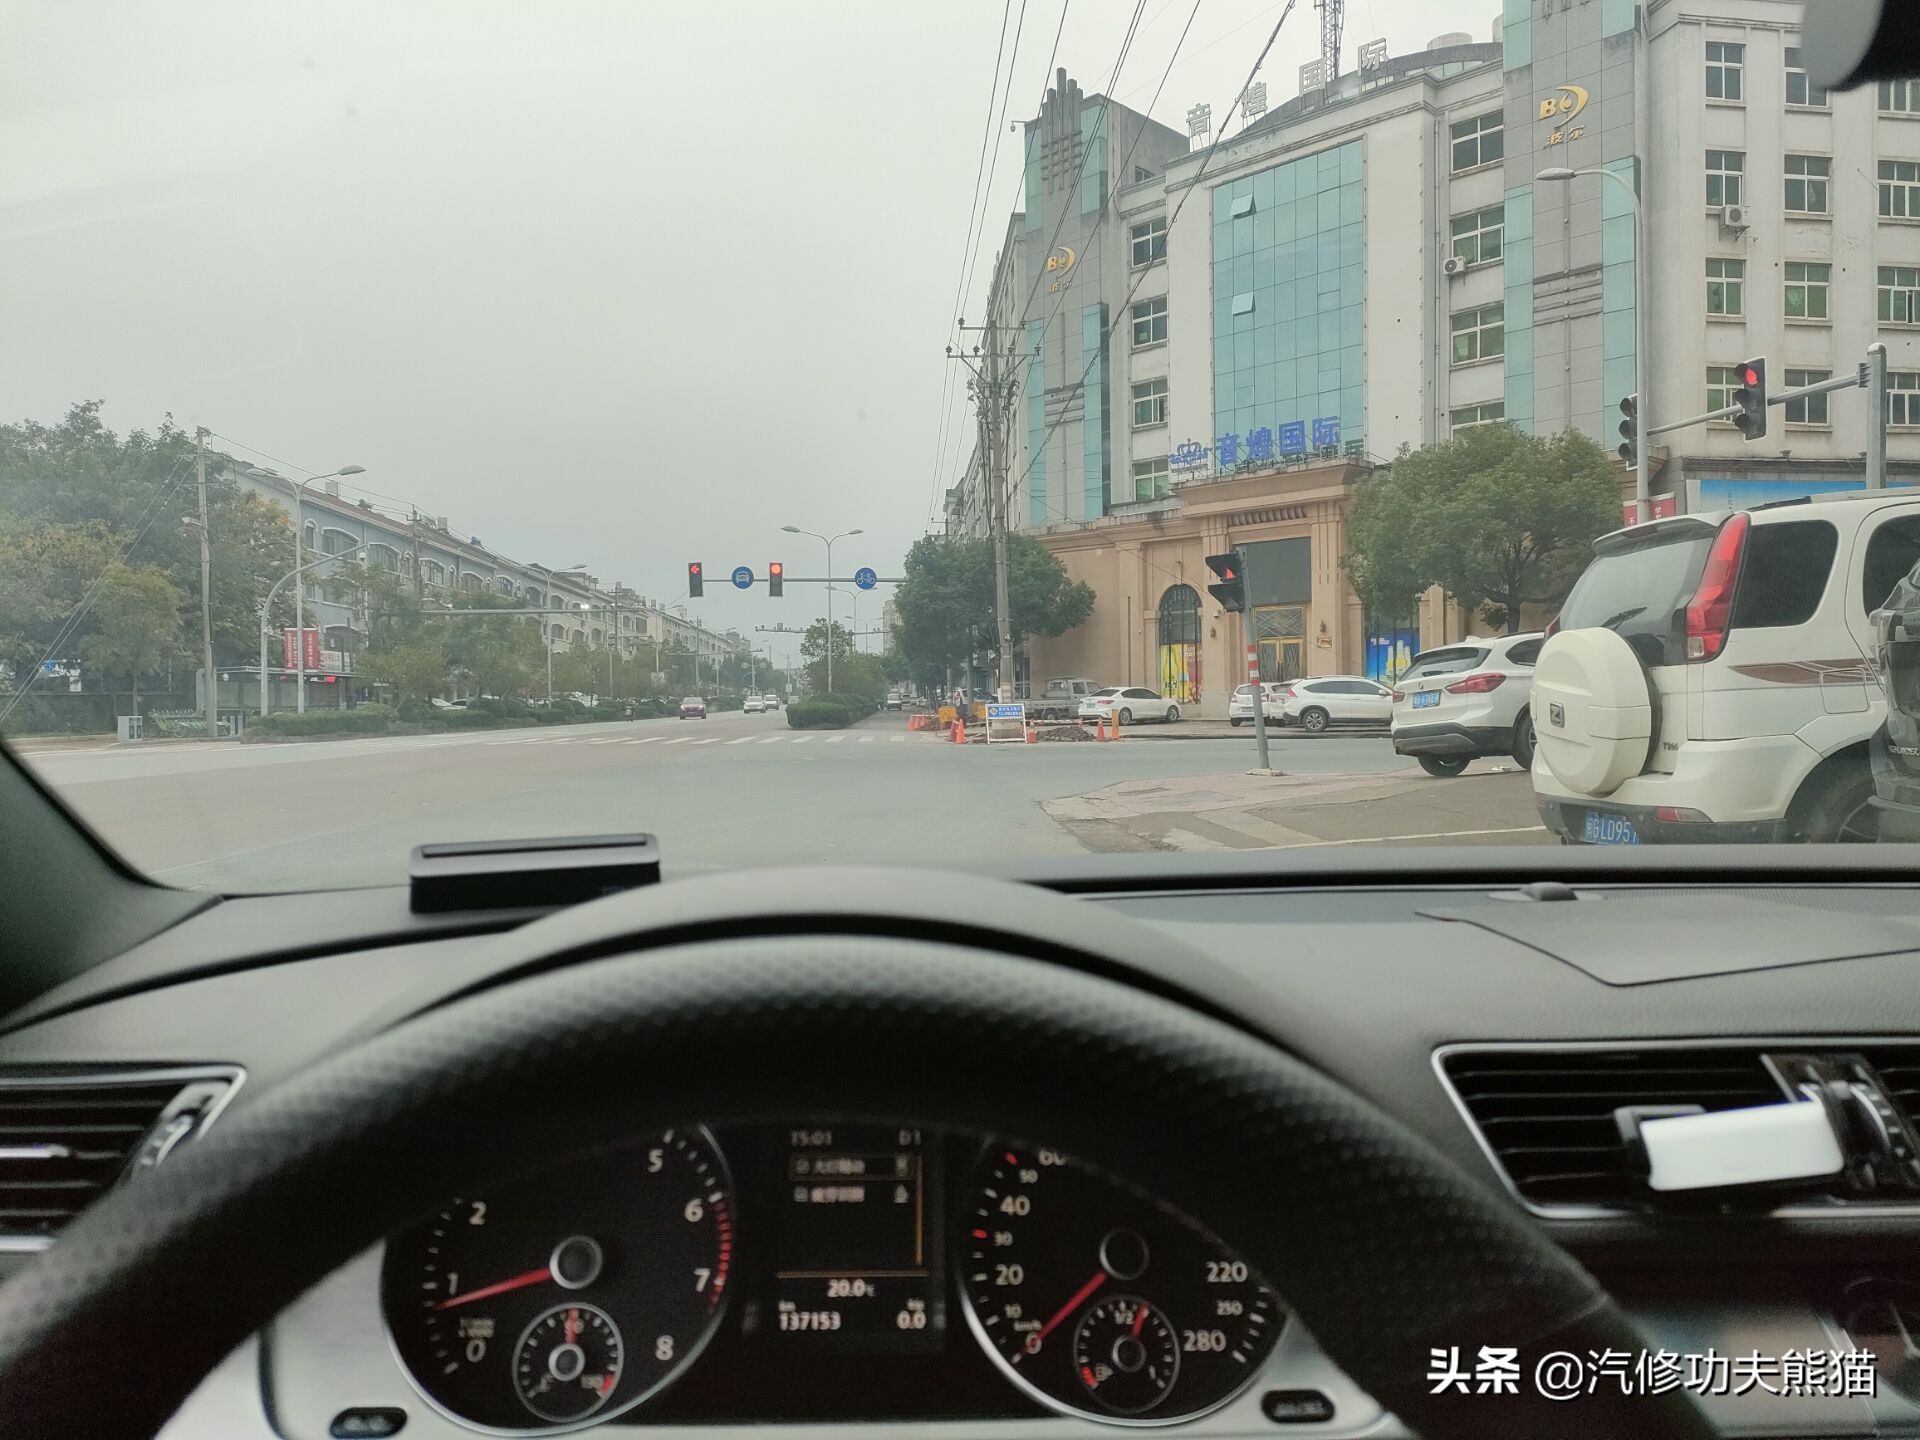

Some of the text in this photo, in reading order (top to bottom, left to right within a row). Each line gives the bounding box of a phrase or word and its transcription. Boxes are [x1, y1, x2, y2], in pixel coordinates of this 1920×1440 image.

[1186, 37, 1389, 137] 音煌国际
[1217, 416, 1341, 466] 音煌国际
[648, 1149, 663, 1173] 5
[469, 1201, 487, 1225] 2
[684, 1198, 704, 1223] 6
[1000, 1195, 1031, 1216] 40
[447, 1272, 460, 1295] 1
[694, 1268, 711, 1293] 7
[995, 1263, 1024, 1286] 20
[1206, 1261, 1248, 1284] 220
[466, 1338, 487, 1364] 0
[655, 1335, 675, 1361] 8
[1183, 1329, 1227, 1352] 280
